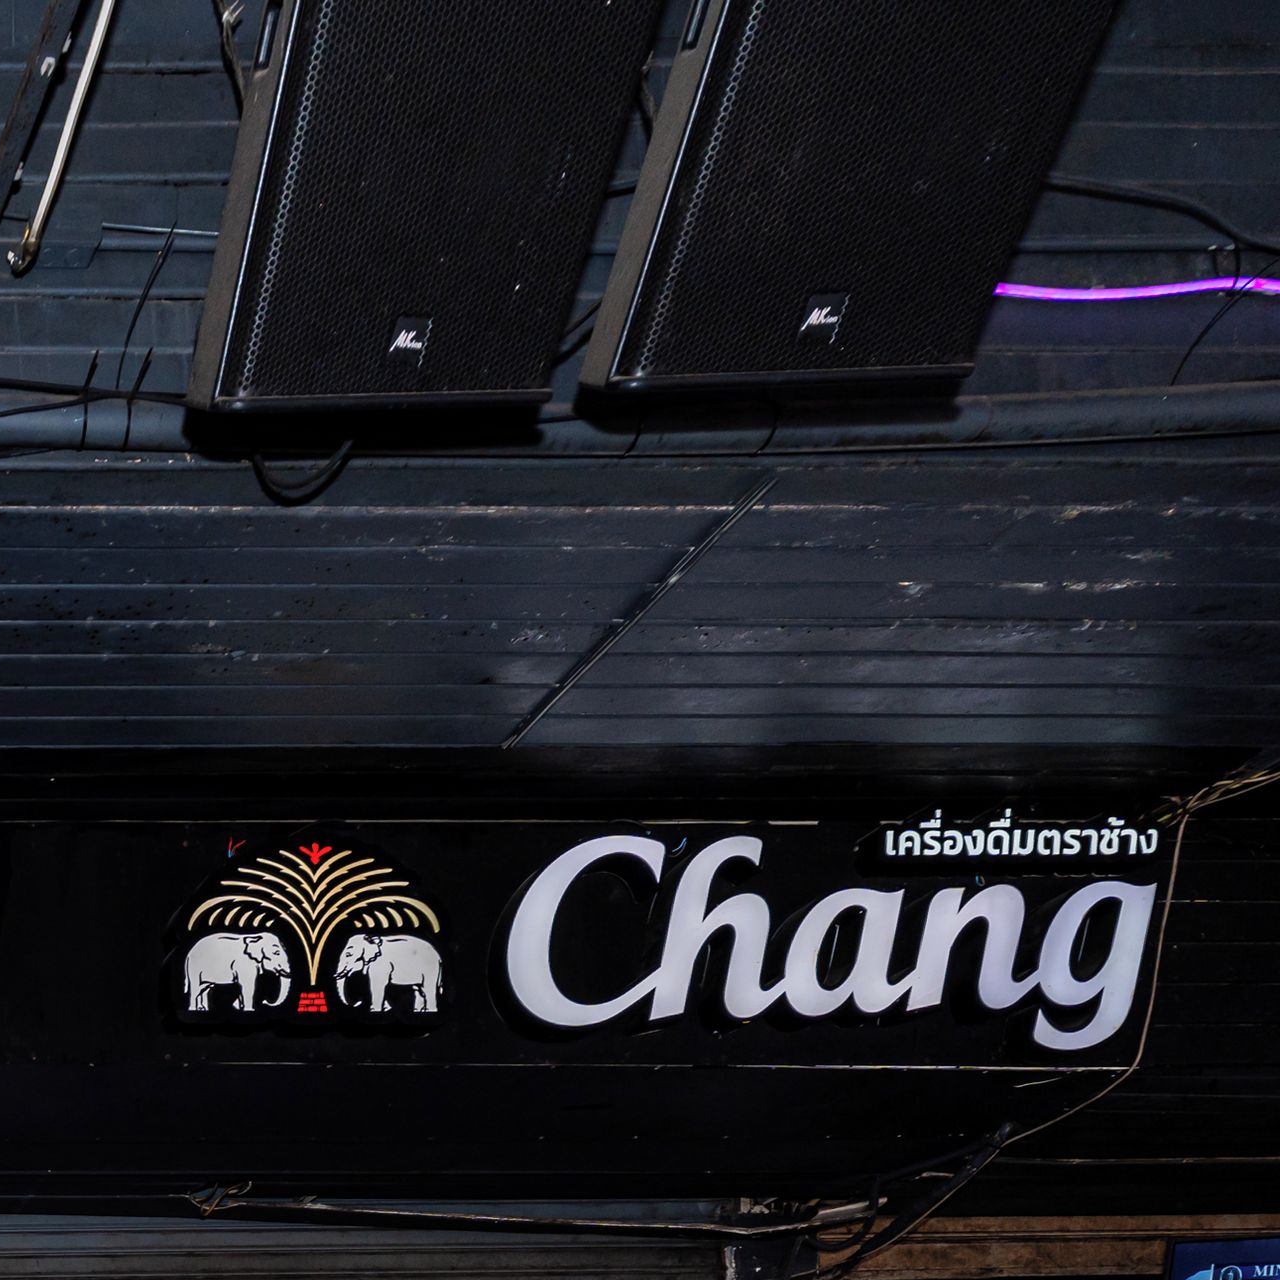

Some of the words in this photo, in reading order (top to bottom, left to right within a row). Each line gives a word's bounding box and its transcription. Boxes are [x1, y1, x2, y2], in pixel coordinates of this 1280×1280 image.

[885, 808, 1159, 856] เครื่องดื่มตราช้าง
[505, 834, 1159, 1053] Chang
